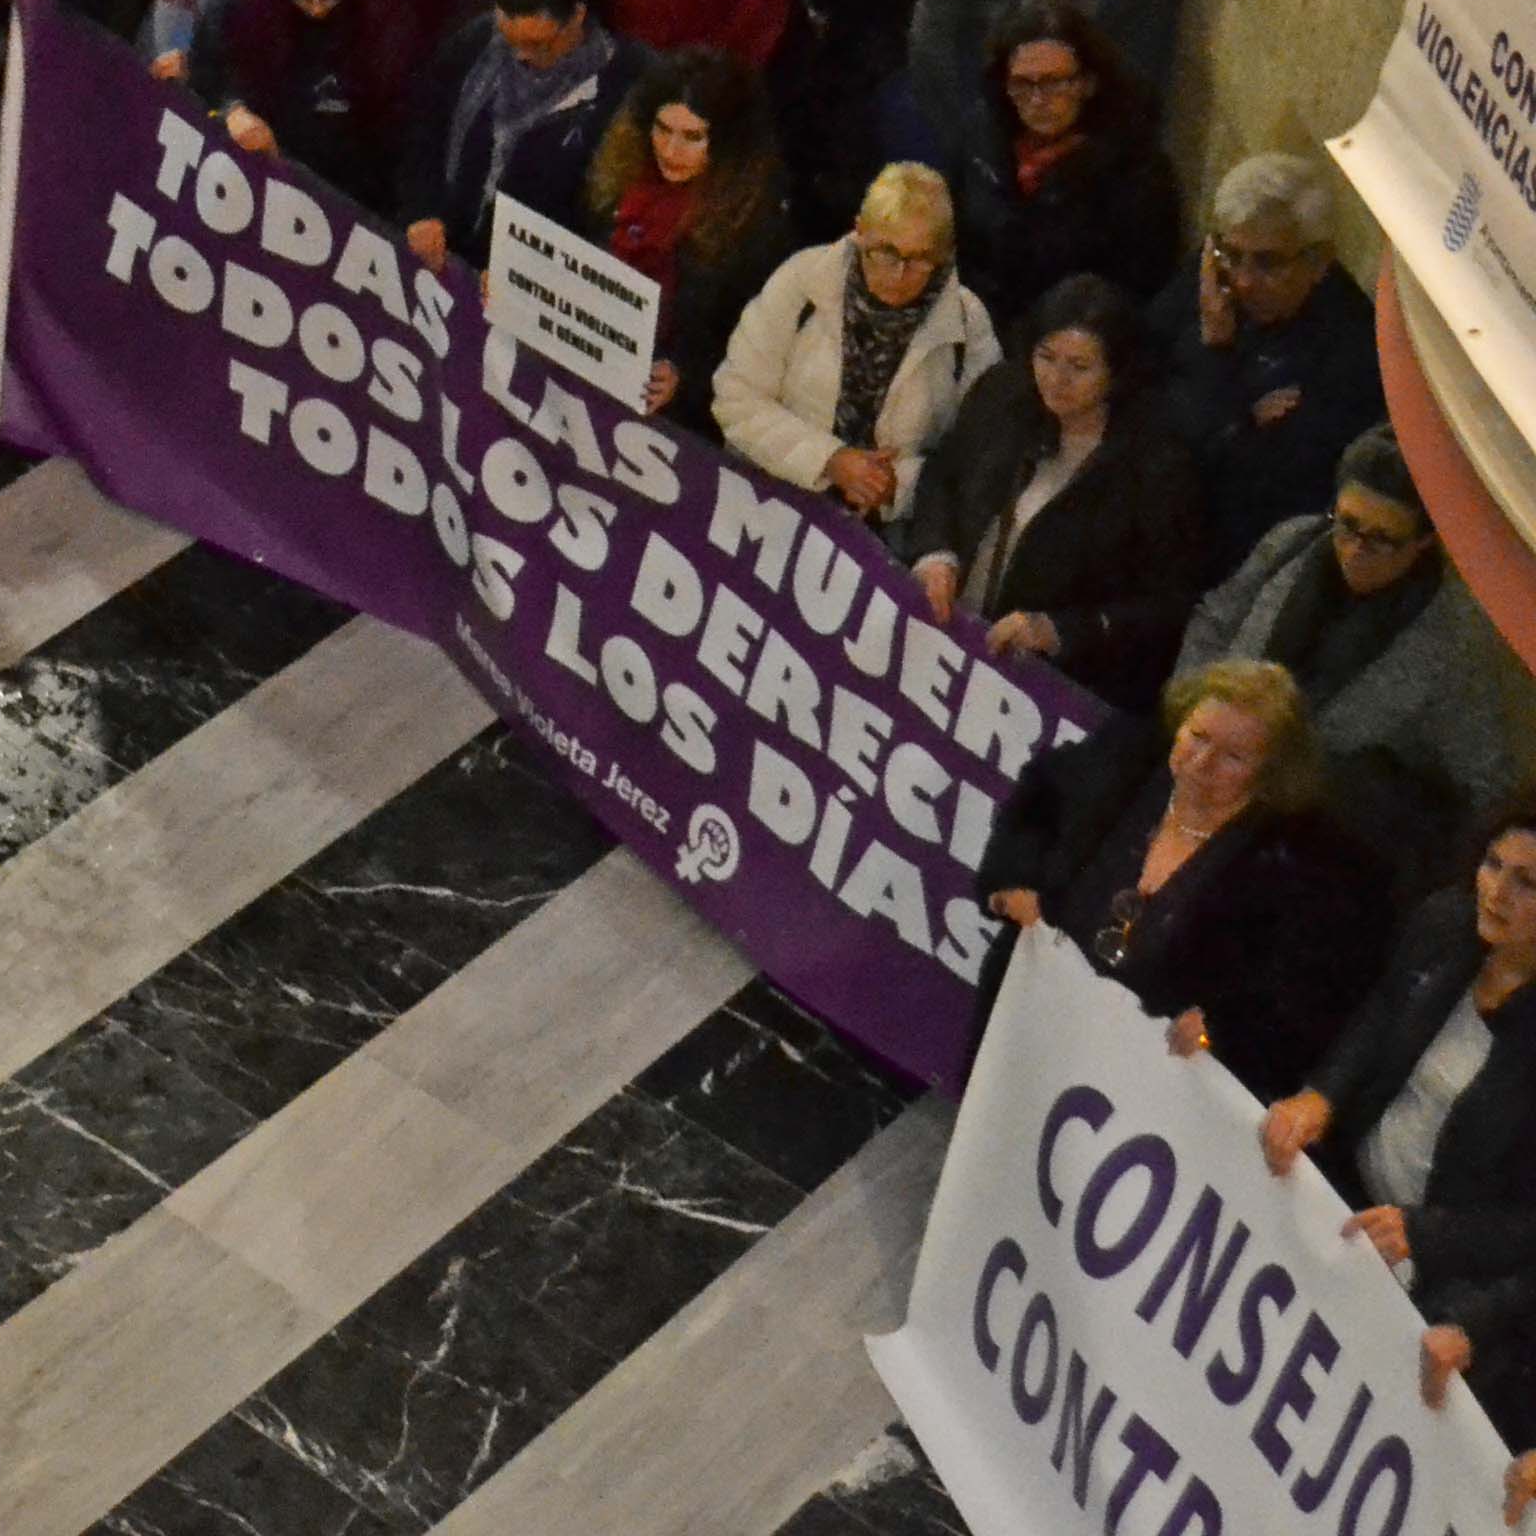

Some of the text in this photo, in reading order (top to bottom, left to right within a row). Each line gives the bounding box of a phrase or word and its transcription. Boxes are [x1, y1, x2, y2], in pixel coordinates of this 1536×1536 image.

[106, 192, 1001, 869] TODOS LOS DEREC
[156, 109, 1094, 781] TODAS LAS MUJER
[508, 267, 638, 356] CONTRA LA VIOLENCIA
[228, 358, 1001, 987] TODOS LOS DÍAS
[602, 761, 673, 835] Jerez
[1036, 1085, 1414, 1536] CONSEJO
